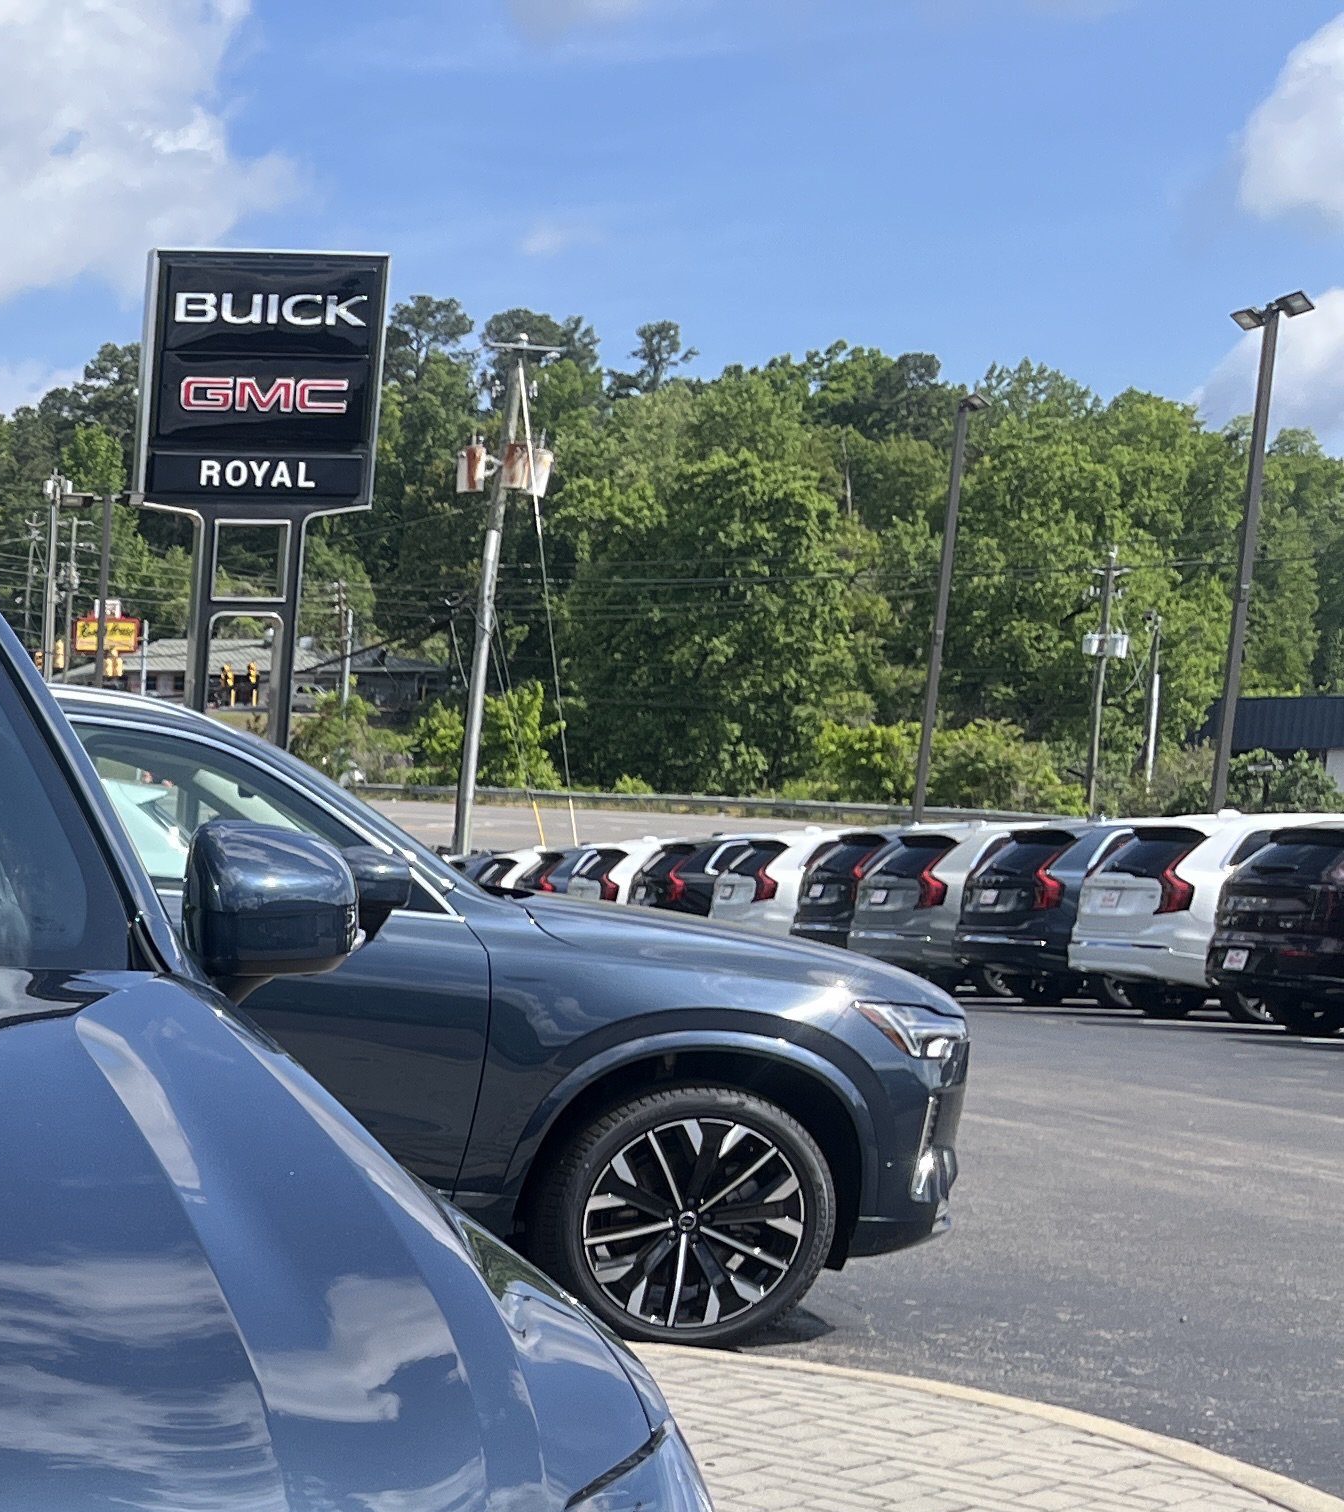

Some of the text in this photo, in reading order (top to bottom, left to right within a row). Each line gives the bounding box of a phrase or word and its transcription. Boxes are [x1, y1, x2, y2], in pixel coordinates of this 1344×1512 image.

[174, 292, 368, 326] BUICK
[180, 376, 349, 413] GMC
[200, 460, 315, 488] ROYAL
